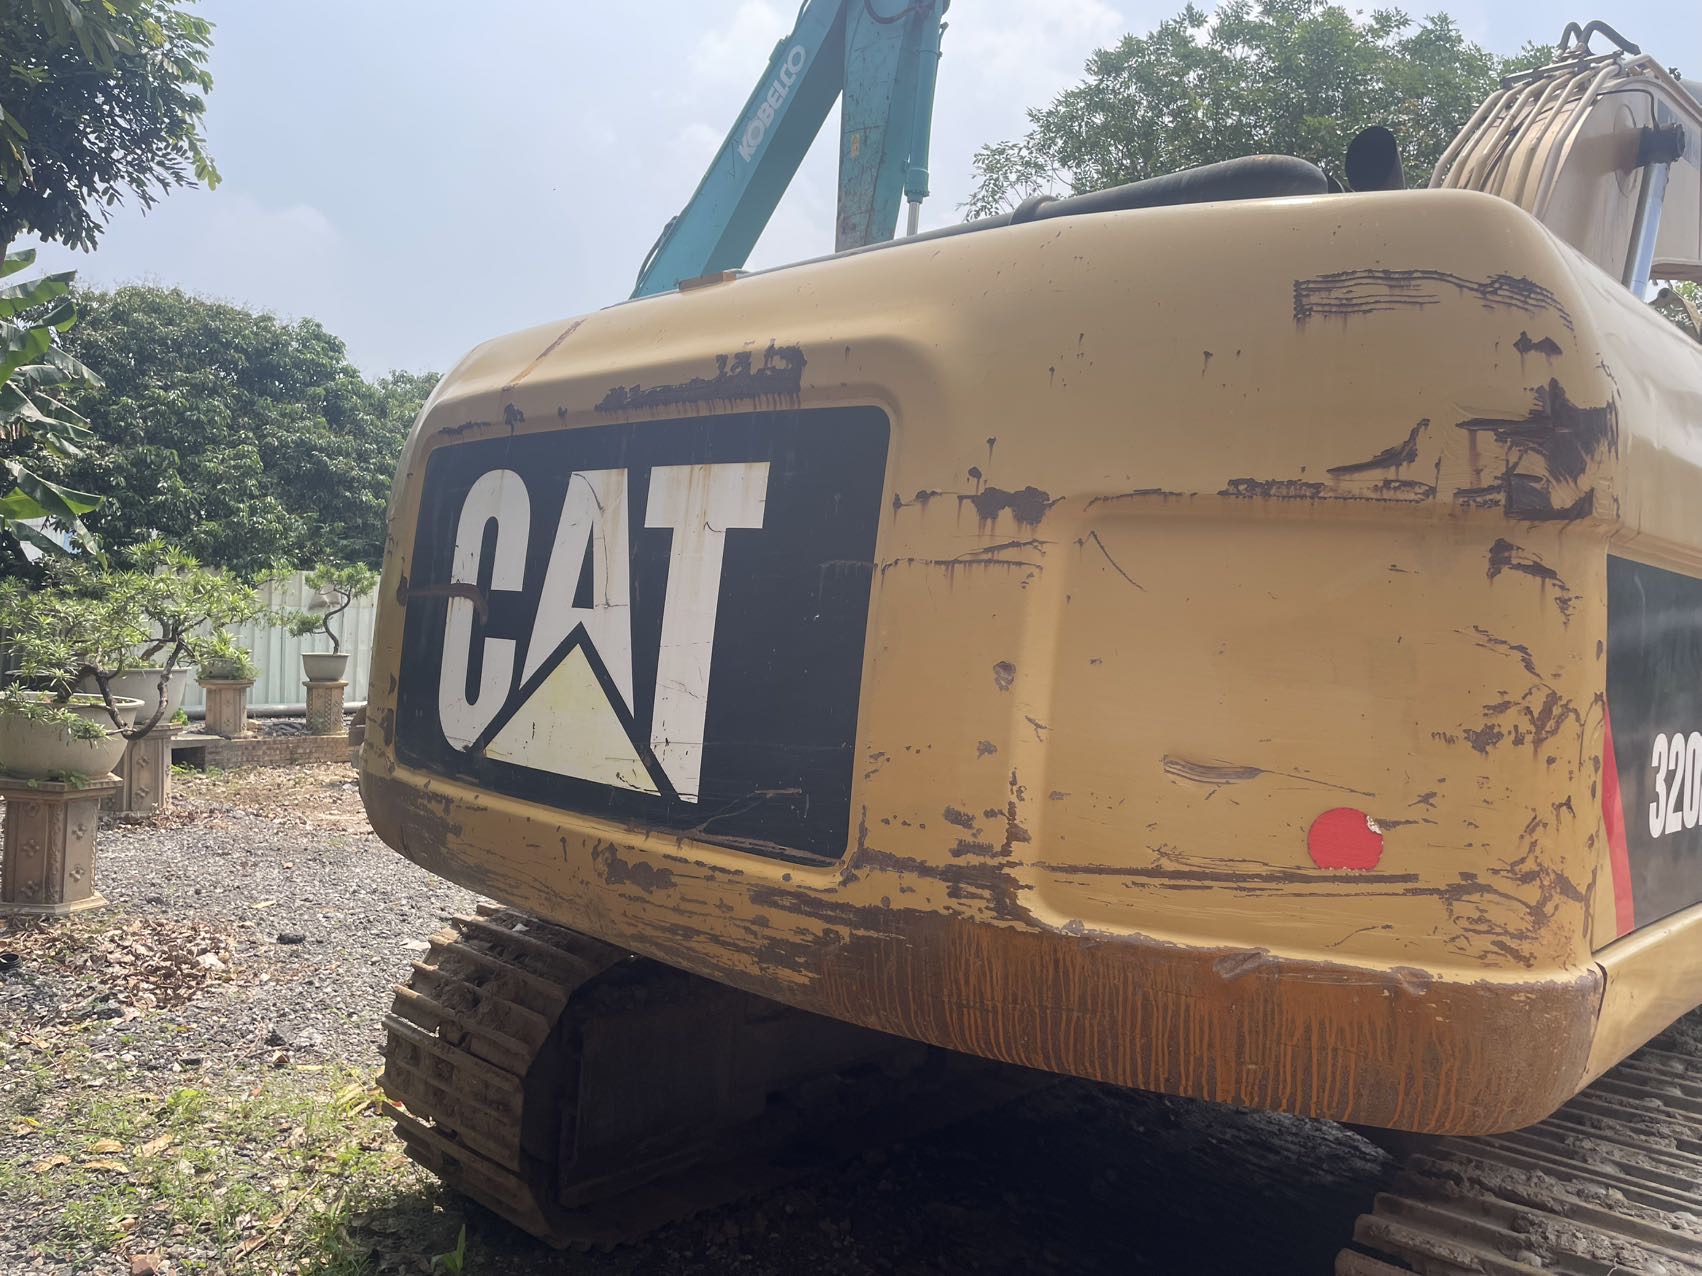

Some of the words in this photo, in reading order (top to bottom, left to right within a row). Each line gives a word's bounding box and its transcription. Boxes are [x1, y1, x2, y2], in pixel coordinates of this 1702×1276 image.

[737, 44, 806, 163] KOBELCO
[439, 461, 770, 804] CAT
[1649, 731, 1702, 838] 320
